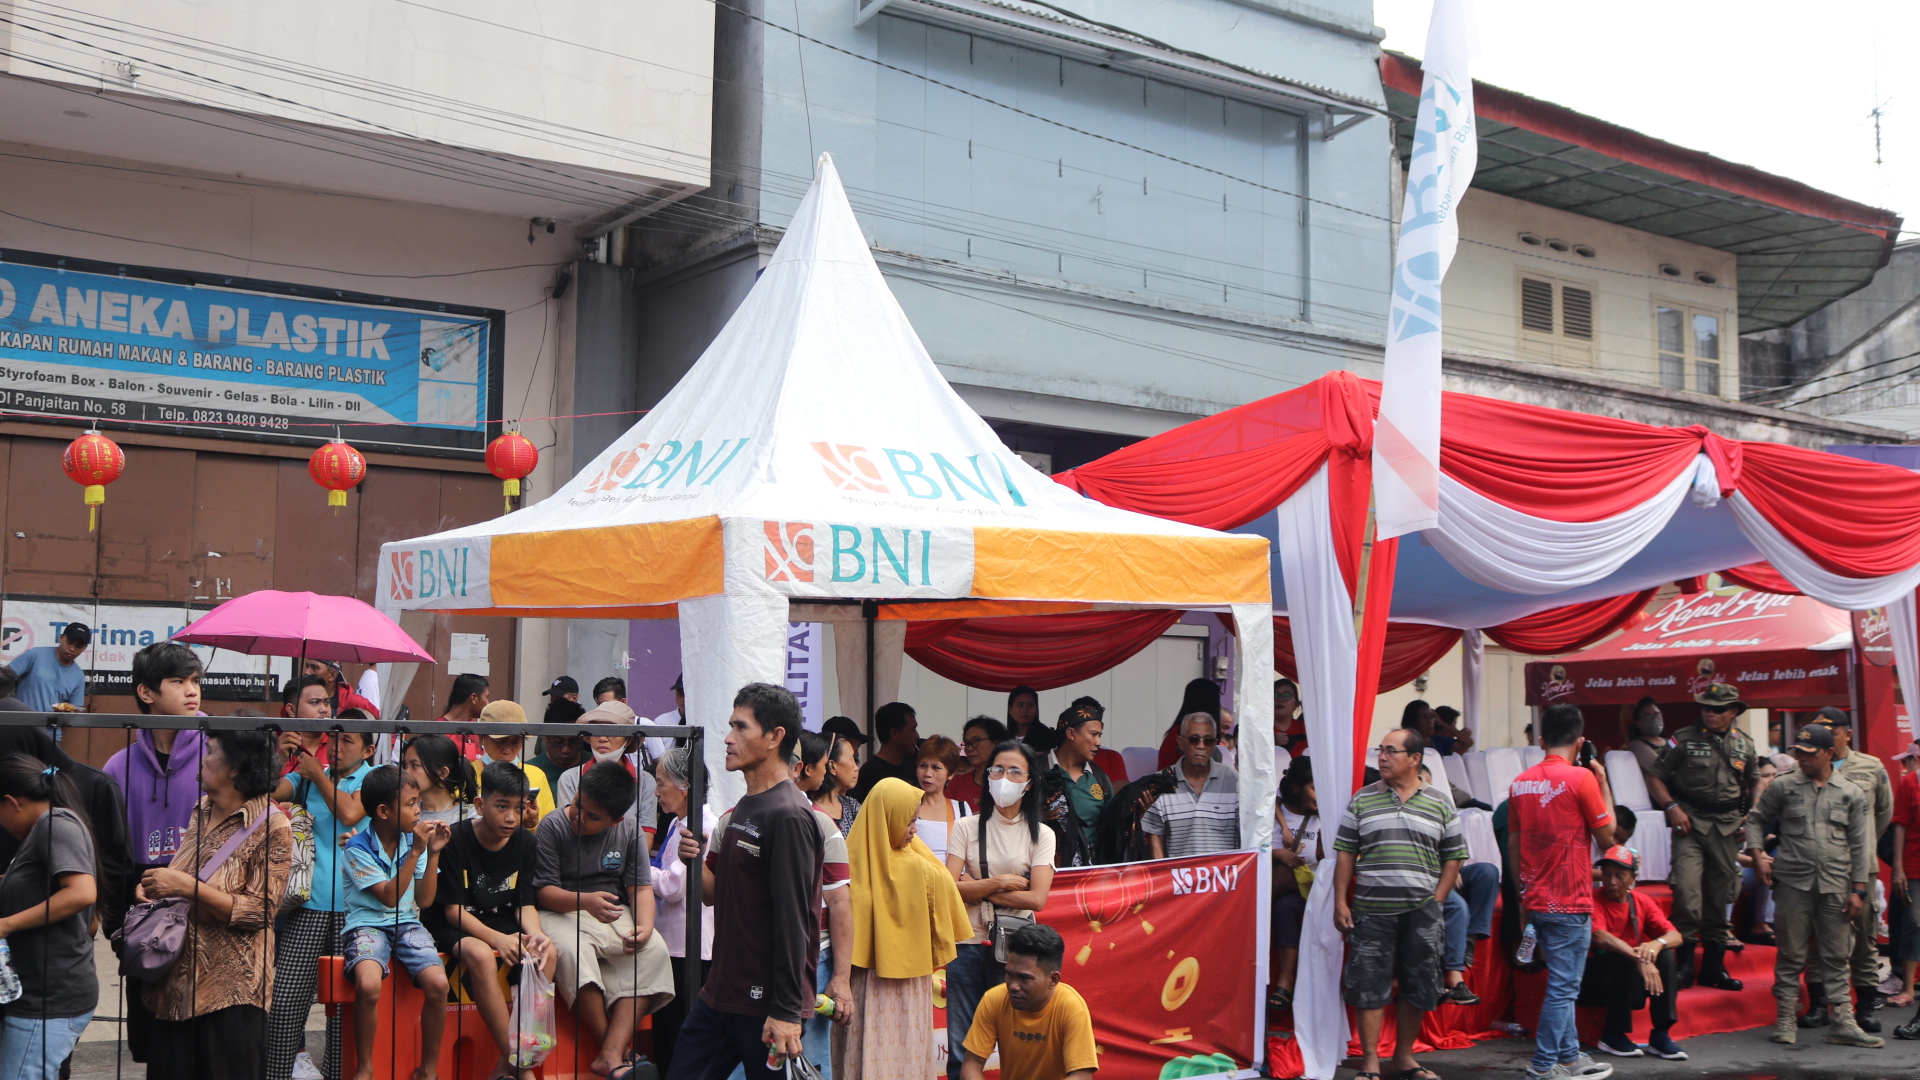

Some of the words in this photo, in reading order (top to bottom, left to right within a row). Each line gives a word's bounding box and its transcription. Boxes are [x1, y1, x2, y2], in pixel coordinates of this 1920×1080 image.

[29, 283, 194, 341] ANEKA
[208, 304, 391, 361] PLASTIK
[58, 337, 114, 359] RUMAH
[118, 344, 173, 365] MAKAN
[177, 351, 188, 367] &
[193, 352, 253, 373] BARANG
[266, 359, 324, 380] BARANG
[328, 365, 386, 386] PLASTIK
[0, 366, 66, 384] Styrofoam
[71, 374, 96, 388] Box
[109, 378, 145, 392] Balon
[157, 383, 212, 398] Souvenir
[224, 389, 258, 403] Gelas
[270, 394, 297, 406] Bola
[309, 397, 334, 409] Lilin
[15, 392, 79, 411] Panjaitan
[84, 399, 106, 414] No.
[110, 403, 126, 416] 58
[158, 406, 188, 422] Telp.
[193, 409, 223, 423] 0823
[226, 413, 256, 425] 9480
[260, 416, 289, 429] 9428
[621, 438, 750, 489] BNI
[882, 448, 1028, 507] BNI
[419, 547, 469, 598] BNI
[830, 524, 932, 587] BNI
[1643, 591, 1744, 632] Kapal
[49, 621, 155, 646] Trima
[233, 677, 252, 687] tiap
[1584, 677, 1614, 688] Jelas
[1616, 676, 1645, 687] lebih
[1648, 675, 1677, 686] enak
[1736, 670, 1770, 681] Jelas
[1773, 668, 1806, 680] lebih
[1809, 665, 1838, 677] enak
[1195, 864, 1238, 894] BNI
